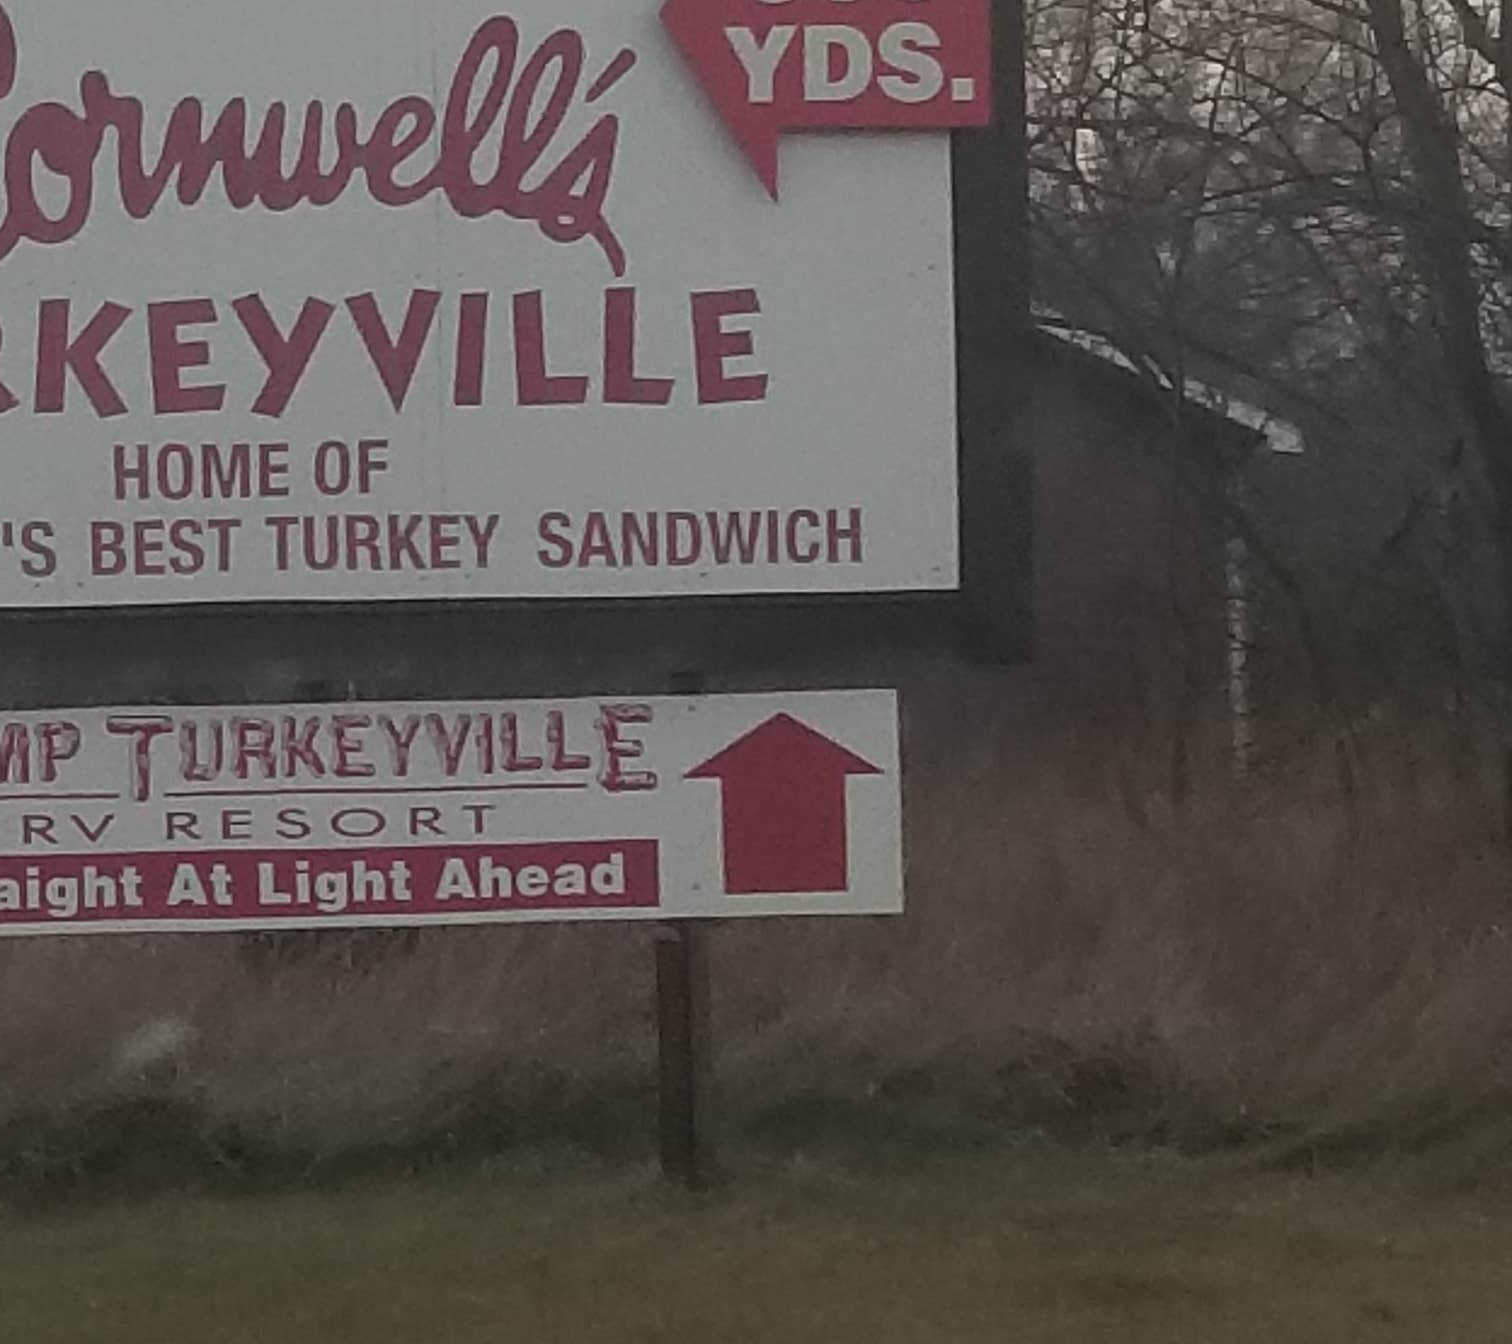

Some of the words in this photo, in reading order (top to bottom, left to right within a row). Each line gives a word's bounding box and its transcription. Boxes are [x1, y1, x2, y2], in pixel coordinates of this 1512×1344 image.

[724, 22, 974, 103] YDS.
[113, 443, 289, 500] HOME
[315, 440, 388, 494] OF
[91, 517, 240, 576] BEST
[266, 514, 499, 572] TURKEY
[537, 507, 863, 568] SANDWICH
[107, 703, 658, 803] TURKEYVILLE
[21, 815, 114, 844] RV
[165, 804, 496, 840] RESORT
[168, 864, 233, 906] At
[258, 861, 412, 911] Light
[435, 853, 626, 899] Ahead
